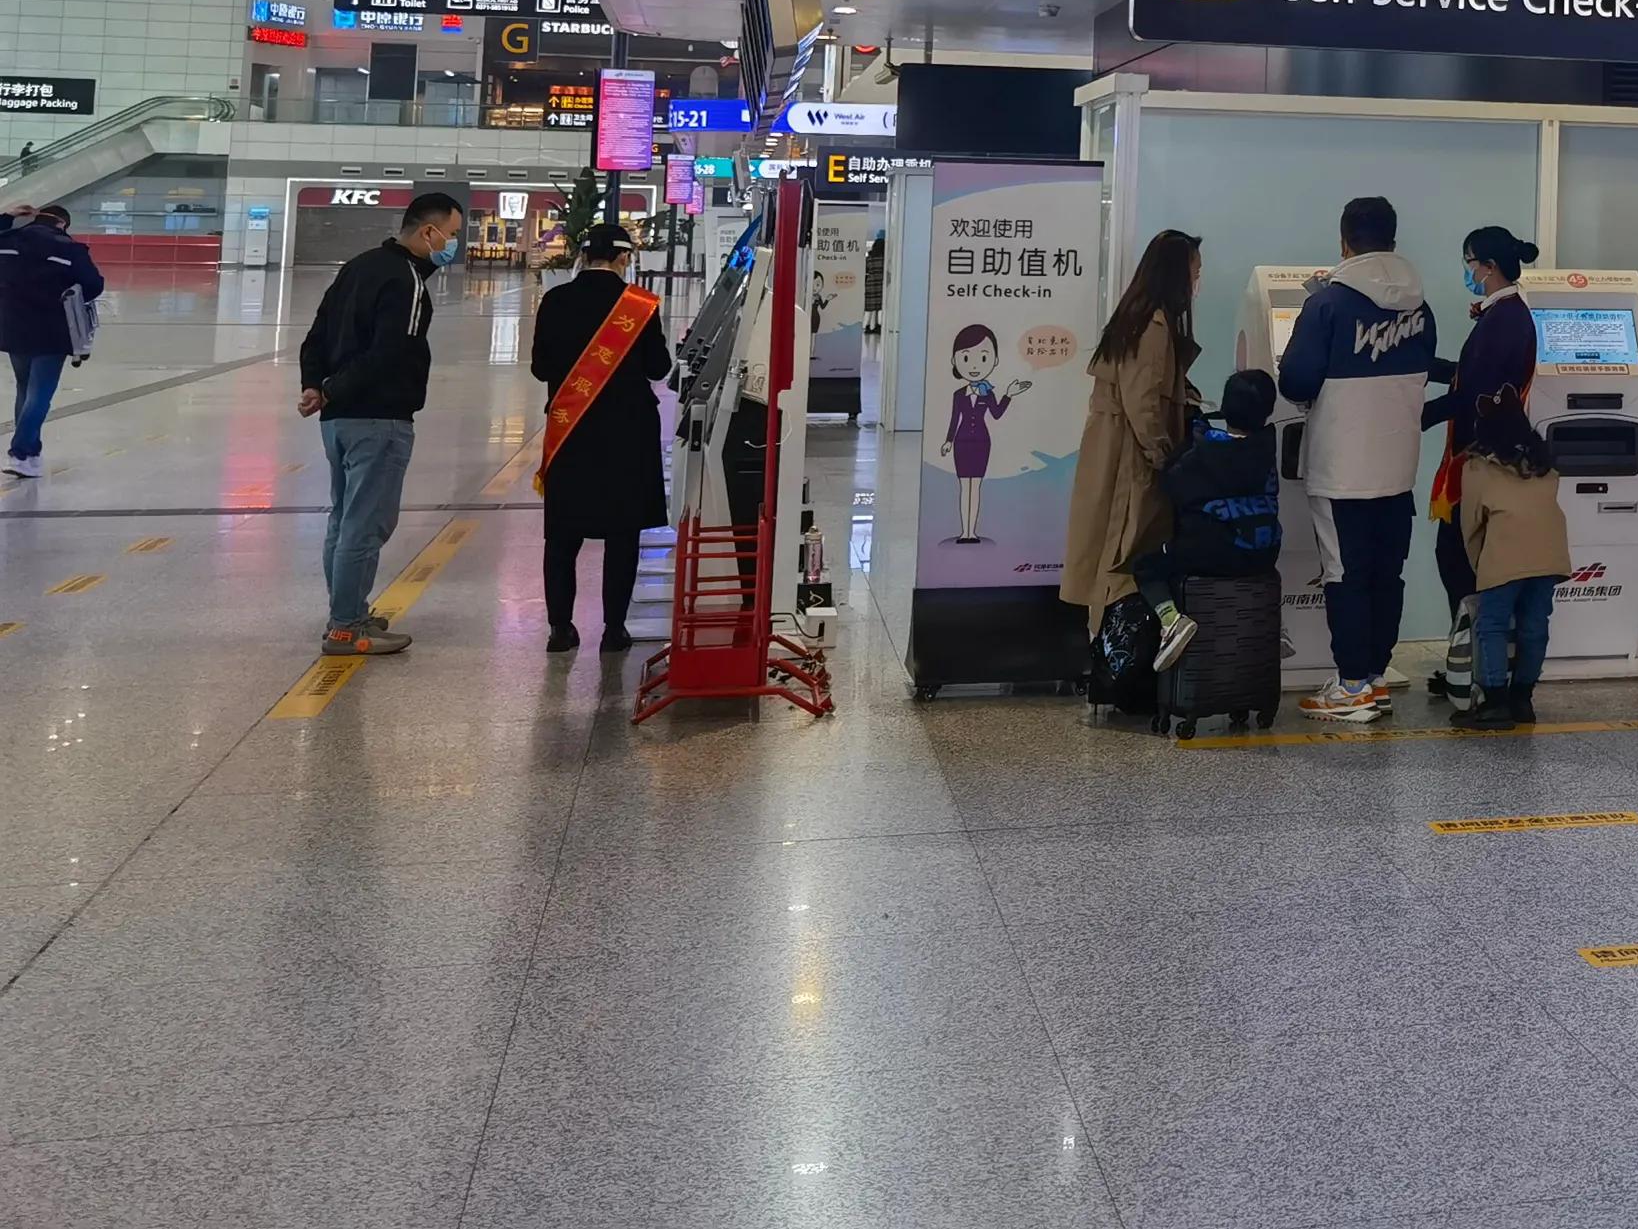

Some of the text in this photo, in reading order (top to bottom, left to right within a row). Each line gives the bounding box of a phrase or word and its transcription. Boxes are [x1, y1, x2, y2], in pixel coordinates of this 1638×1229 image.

[564, 5, 590, 14] Police
[361, 11, 424, 25] 中原银行
[542, 21, 614, 36] STARBUC
[501, 23, 529, 54] G
[0, 83, 54, 97] 行李打包
[40, 99, 78, 110] Packing
[828, 155, 847, 183] E
[848, 173, 889, 185] Self Serv
[331, 190, 381, 206] KFC
[949, 218, 1033, 239] 欢迎使用
[948, 247, 1082, 277] 自助值机
[947, 284, 1051, 298] Self Check-in
